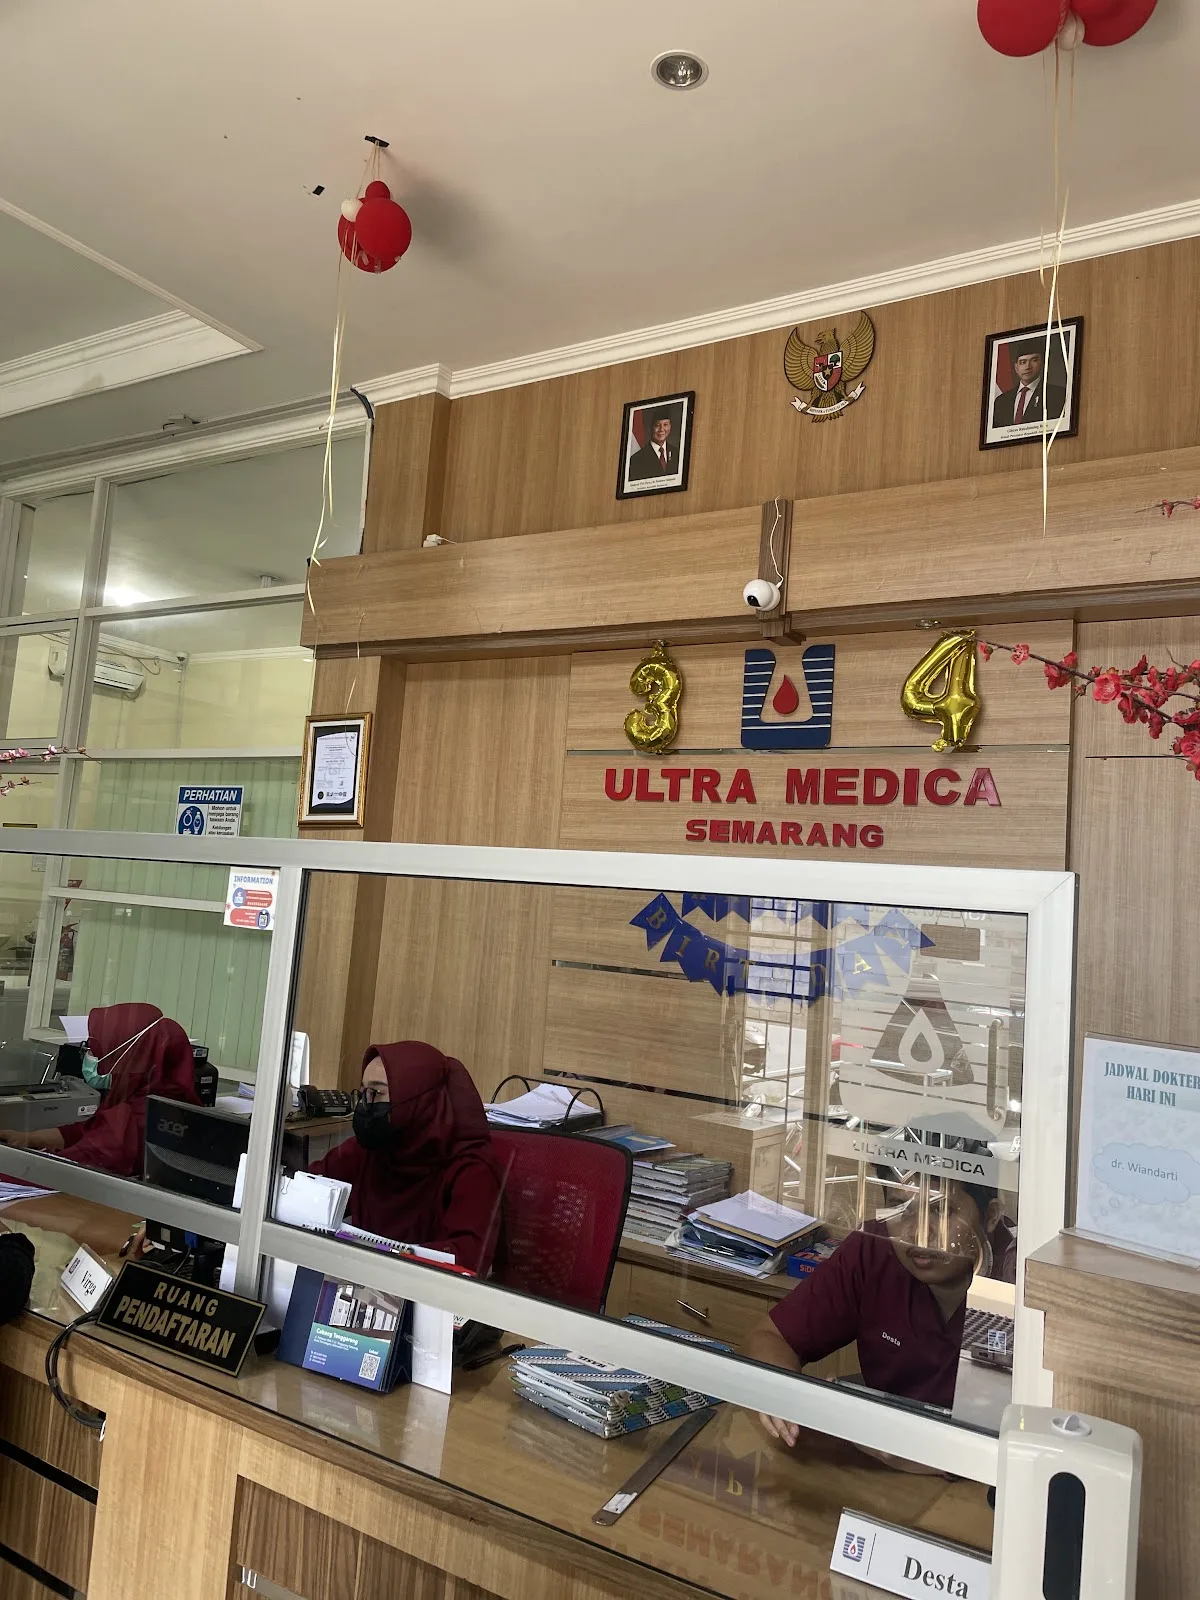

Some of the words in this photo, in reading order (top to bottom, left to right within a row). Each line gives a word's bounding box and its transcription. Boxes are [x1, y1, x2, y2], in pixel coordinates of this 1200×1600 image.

[623, 650, 683, 755] 3
[900, 629, 982, 753] 4
[183, 789, 238, 802] PERHATIAN
[604, 766, 757, 805] ULTRA
[785, 766, 1002, 807] MEDICA
[685, 819, 885, 848] SEMARANG
[233, 875, 274, 885] INFORMATION
[1103, 1061, 1149, 1082] JADWAL
[1126, 1085, 1156, 1104] HARI
[1159, 1091, 1177, 1108] INI
[157, 1117, 189, 1138] acer
[914, 1152, 986, 1177] MEDICA
[1111, 1158, 1125, 1170] dr.
[1127, 1162, 1179, 1182] Wiandarti
[154, 1281, 219, 1316] RUANG
[112, 1295, 238, 1361] PENDAFTARAN
[881, 1331, 902, 1347] Desta
[902, 1555, 970, 1600] Desta
